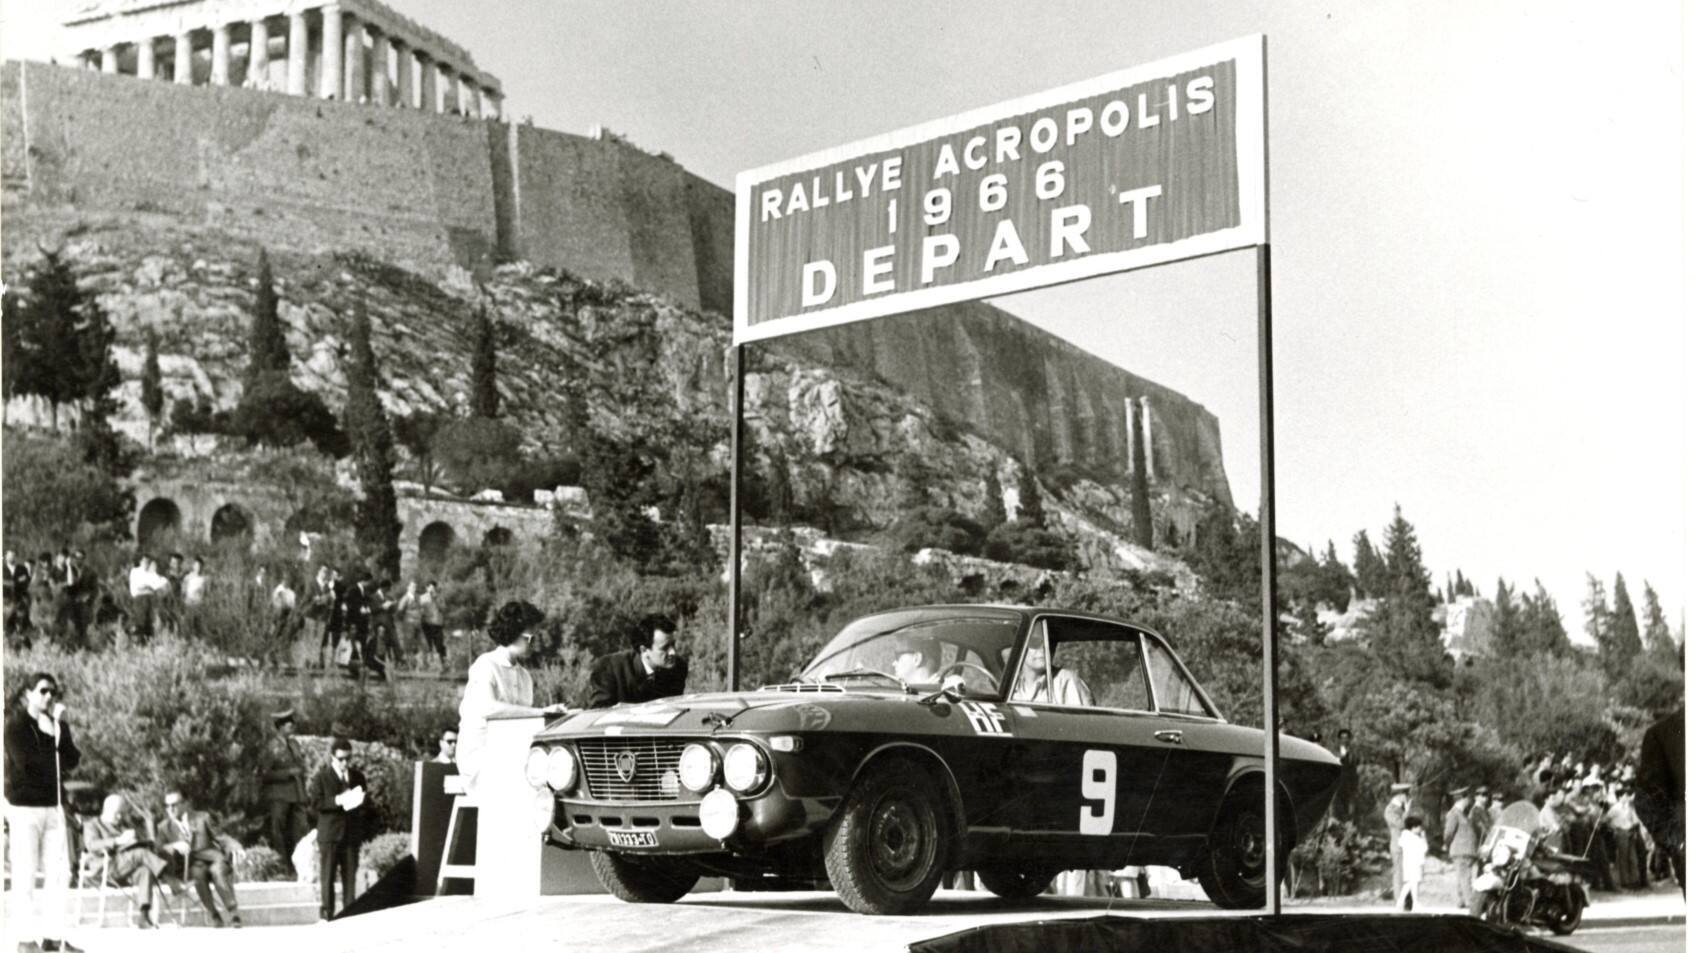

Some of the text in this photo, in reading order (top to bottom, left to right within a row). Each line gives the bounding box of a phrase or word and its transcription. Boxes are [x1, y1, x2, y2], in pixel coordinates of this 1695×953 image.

[761, 75, 1216, 223] RALLYE ACROPOLIS
[887, 160, 1066, 236] 1966
[801, 184, 1163, 309] DEPART
[958, 702, 1006, 733] HF
[1079, 749, 1117, 836] 9
